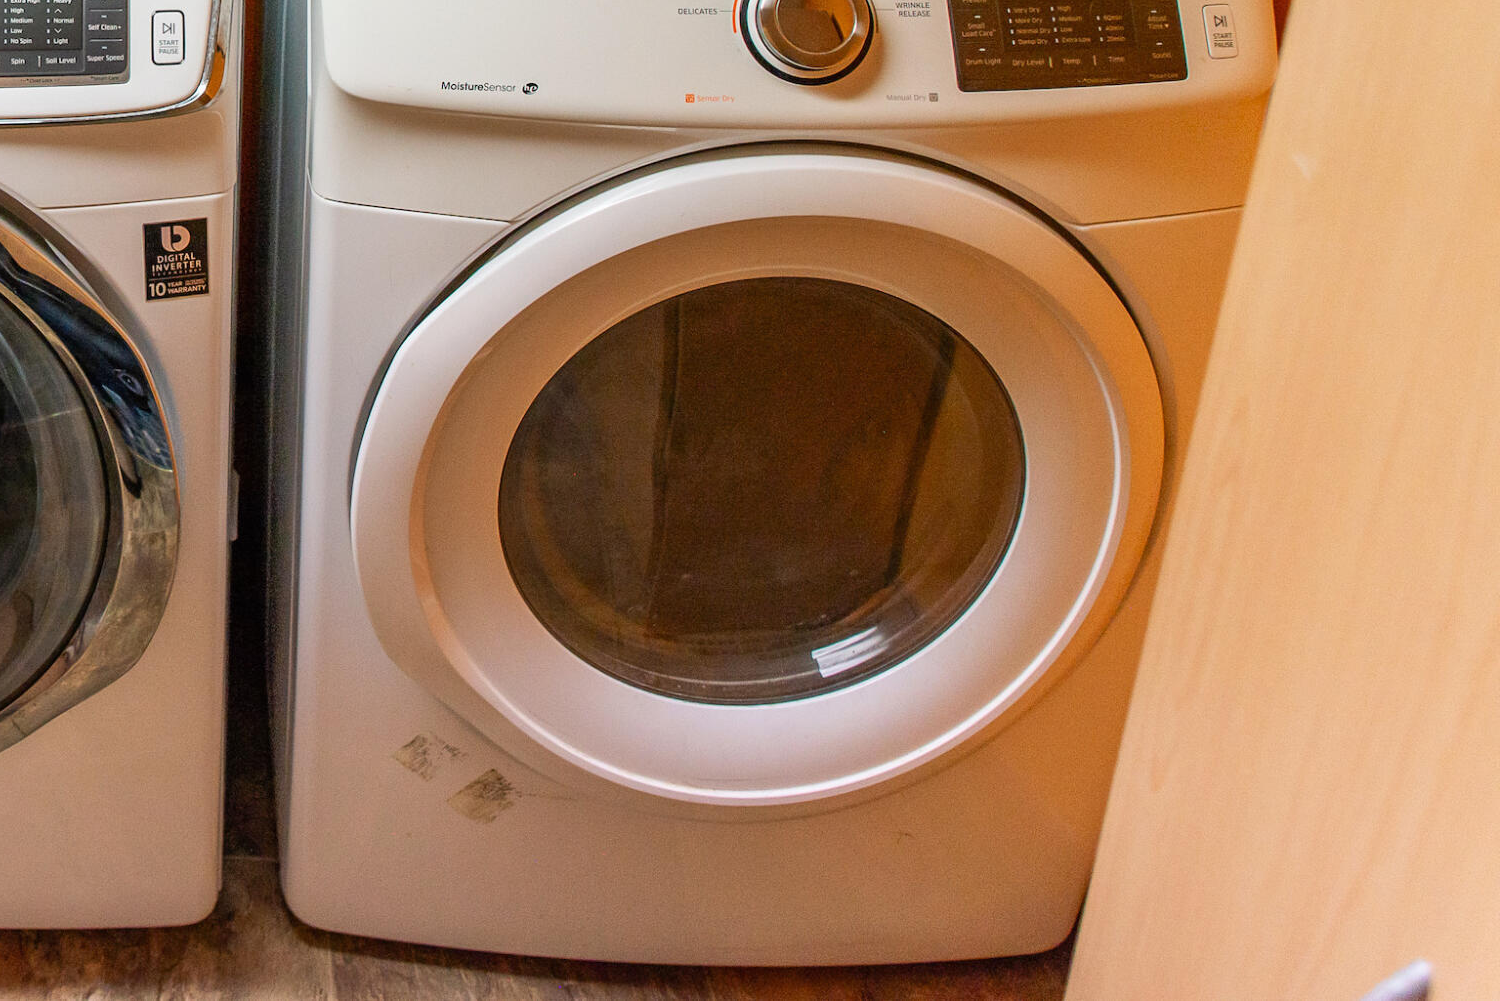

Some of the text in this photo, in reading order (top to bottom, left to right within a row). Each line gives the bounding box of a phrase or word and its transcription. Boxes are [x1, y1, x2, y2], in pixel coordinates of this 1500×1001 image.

[10, 58, 26, 66] Spin
[59, 56, 77, 64] Level
[1012, 59, 1025, 67] Dry
[441, 81, 517, 93] MoistureSensor
[696, 93, 735, 103] Sensor Dry
[886, 93, 927, 103] Manual Dry
[156, 251, 196, 264] DIGITAL
[151, 259, 202, 273] INVERTER
[148, 282, 167, 297] 10
[168, 285, 206, 294] WARRANTY
